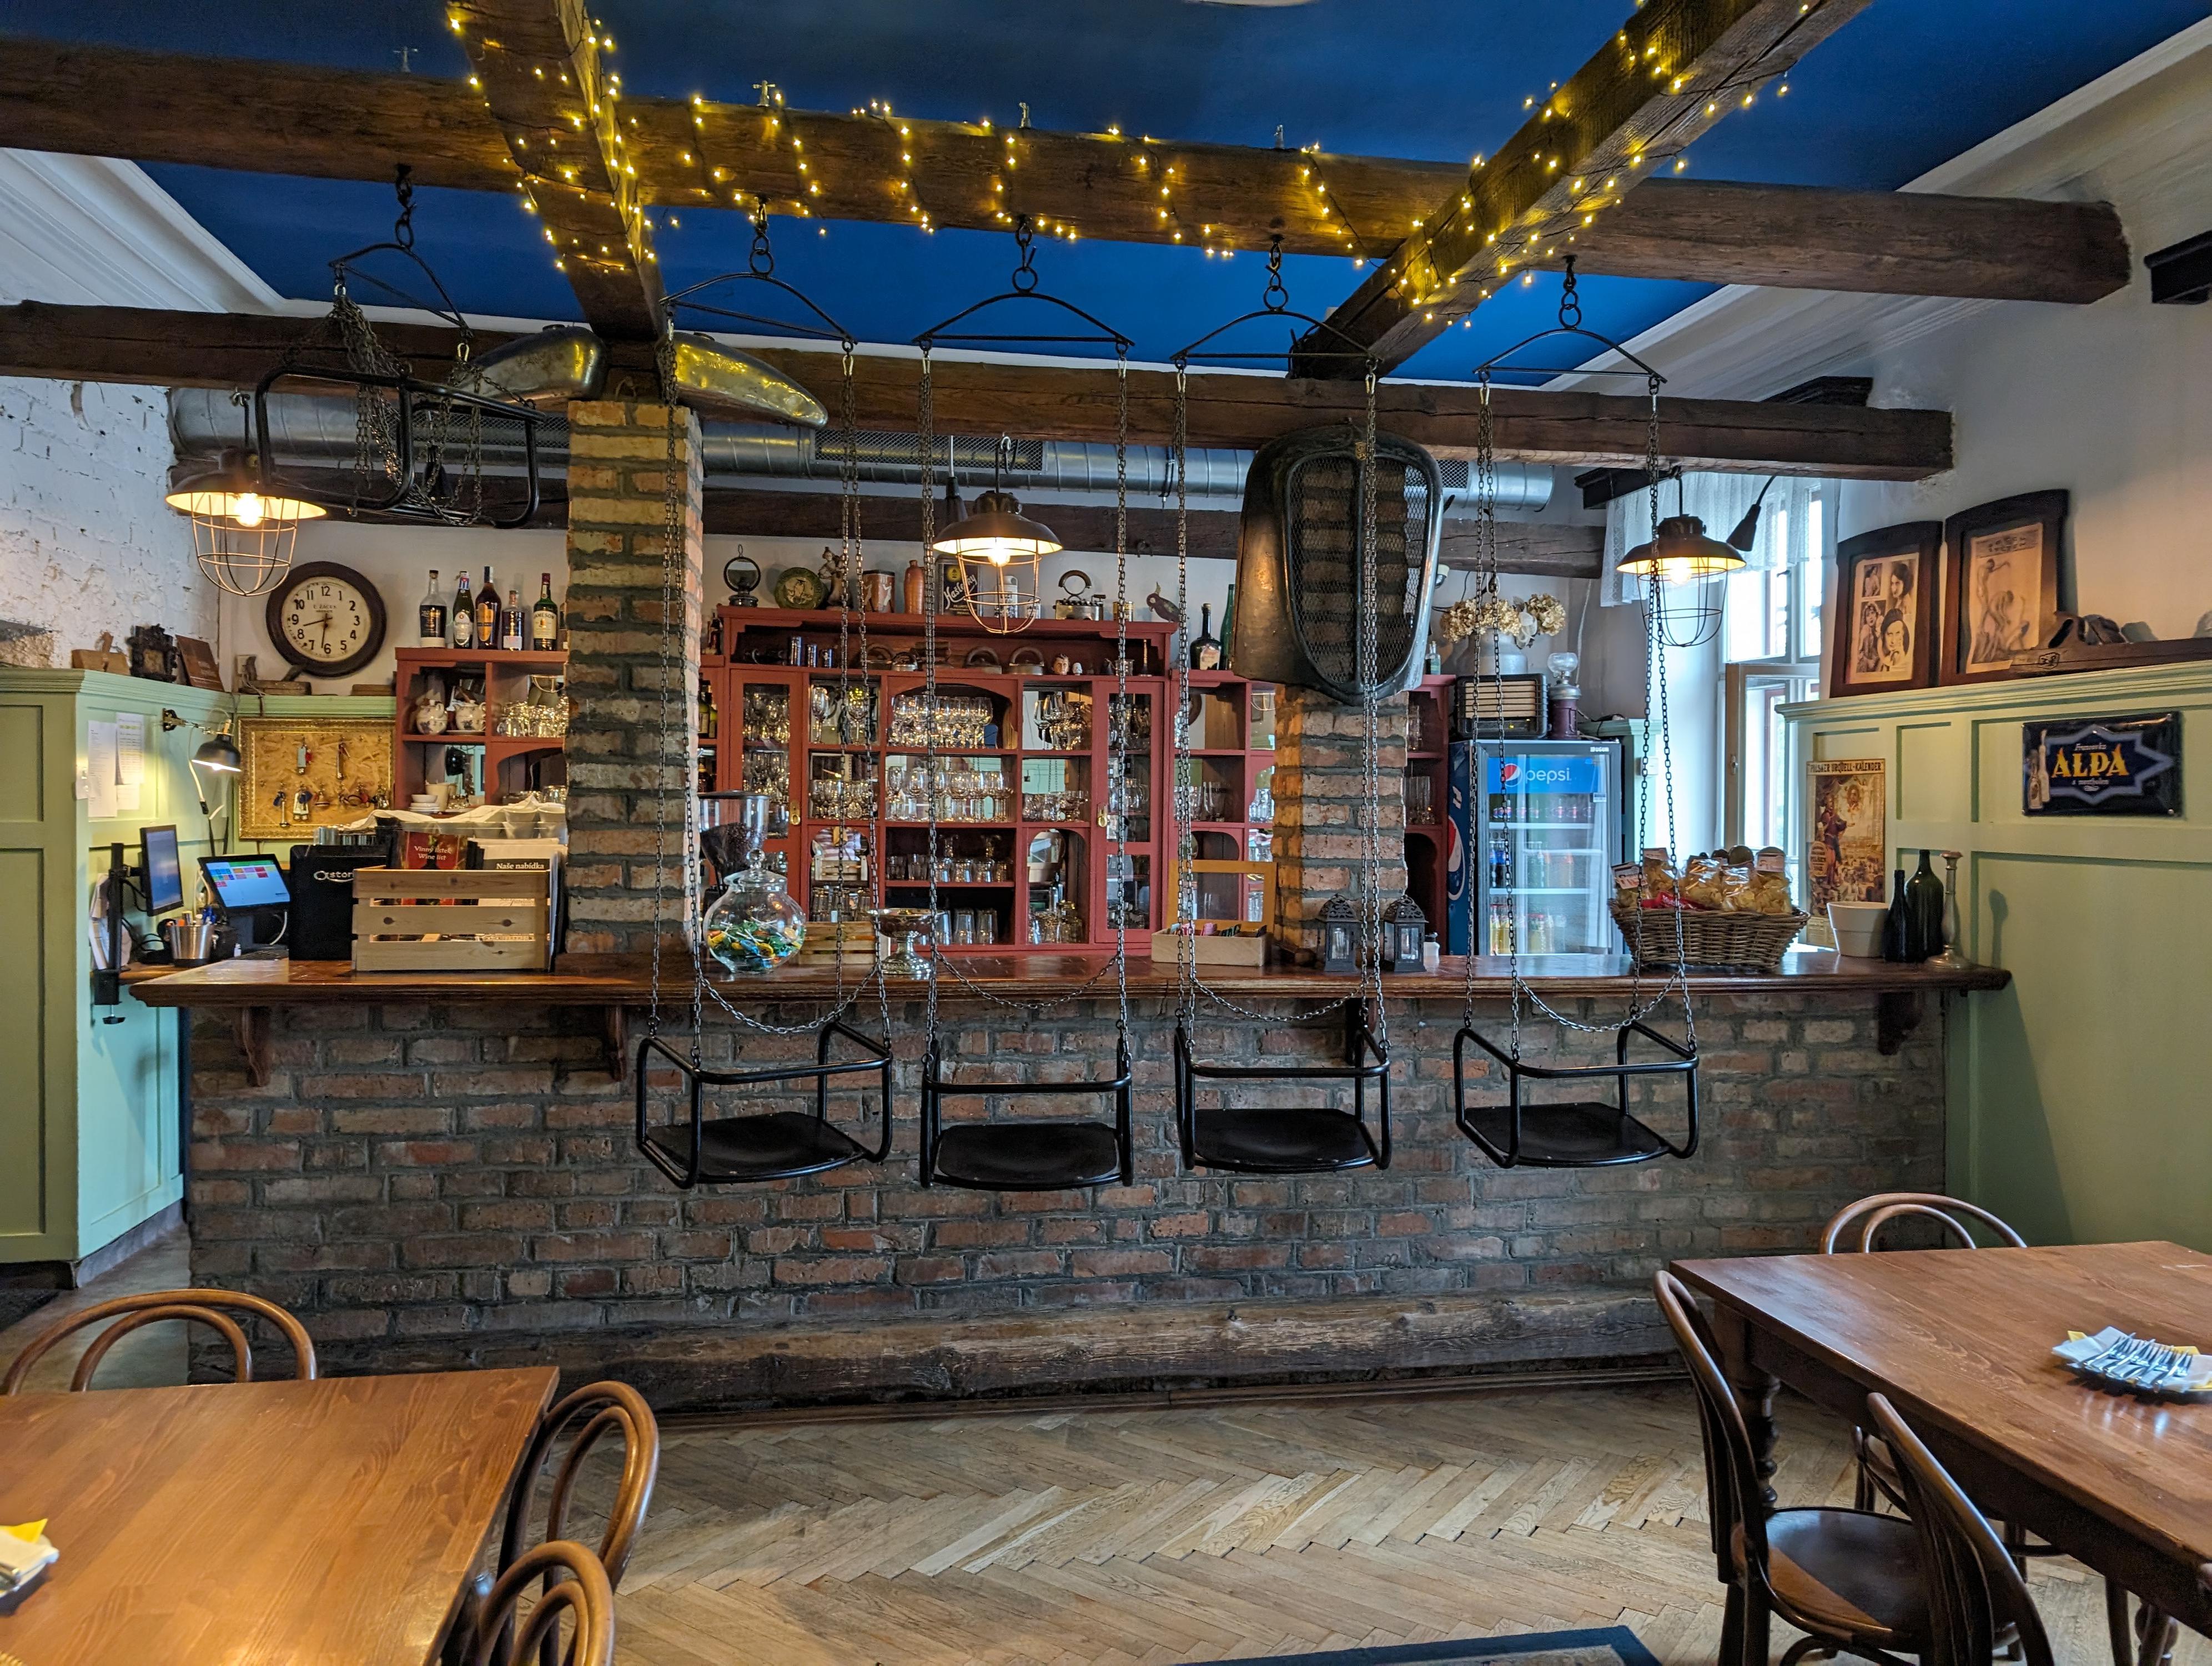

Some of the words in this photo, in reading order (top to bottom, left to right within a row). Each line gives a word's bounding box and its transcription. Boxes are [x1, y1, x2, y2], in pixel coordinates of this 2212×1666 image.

[306, 590, 314, 600] 11
[321, 586, 330, 596] 12
[339, 591, 343, 601] 1
[944, 574, 978, 610] Hašleky
[295, 599, 305, 610] 10
[349, 600, 356, 611] 2
[291, 614, 299, 625] 9
[354, 615, 360, 626] 3
[297, 629, 305, 639] 8
[350, 630, 356, 640] 4
[308, 640, 314, 650] 7
[324, 643, 331, 654] 6
[340, 640, 347, 650] 5
[2052, 743, 2130, 778] ALPA
[1525, 767, 1570, 784] pepsi
[414, 845, 434, 854] Vinný
